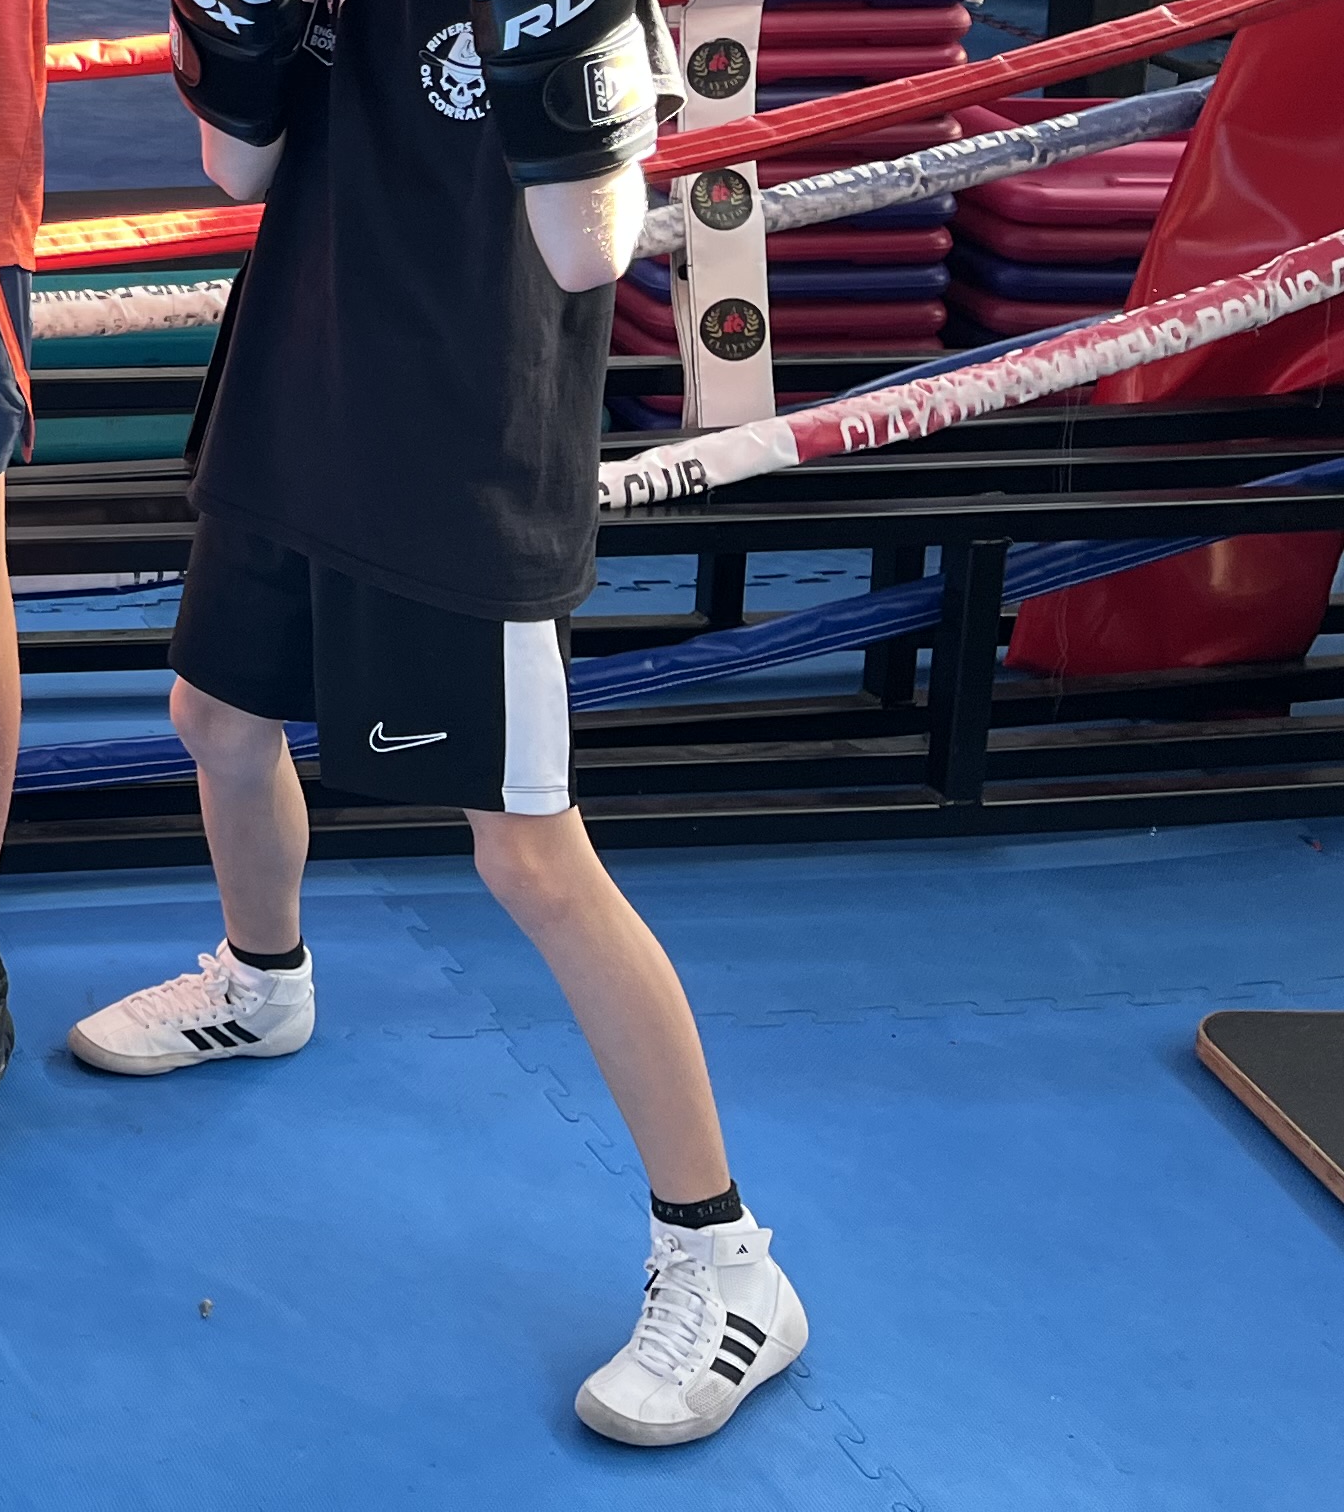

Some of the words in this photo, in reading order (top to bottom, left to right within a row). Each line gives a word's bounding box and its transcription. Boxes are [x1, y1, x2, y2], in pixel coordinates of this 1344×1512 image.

[420, 64, 433, 89] OK
[428, 91, 485, 120] CORRAL
[593, 67, 608, 112] RDX
